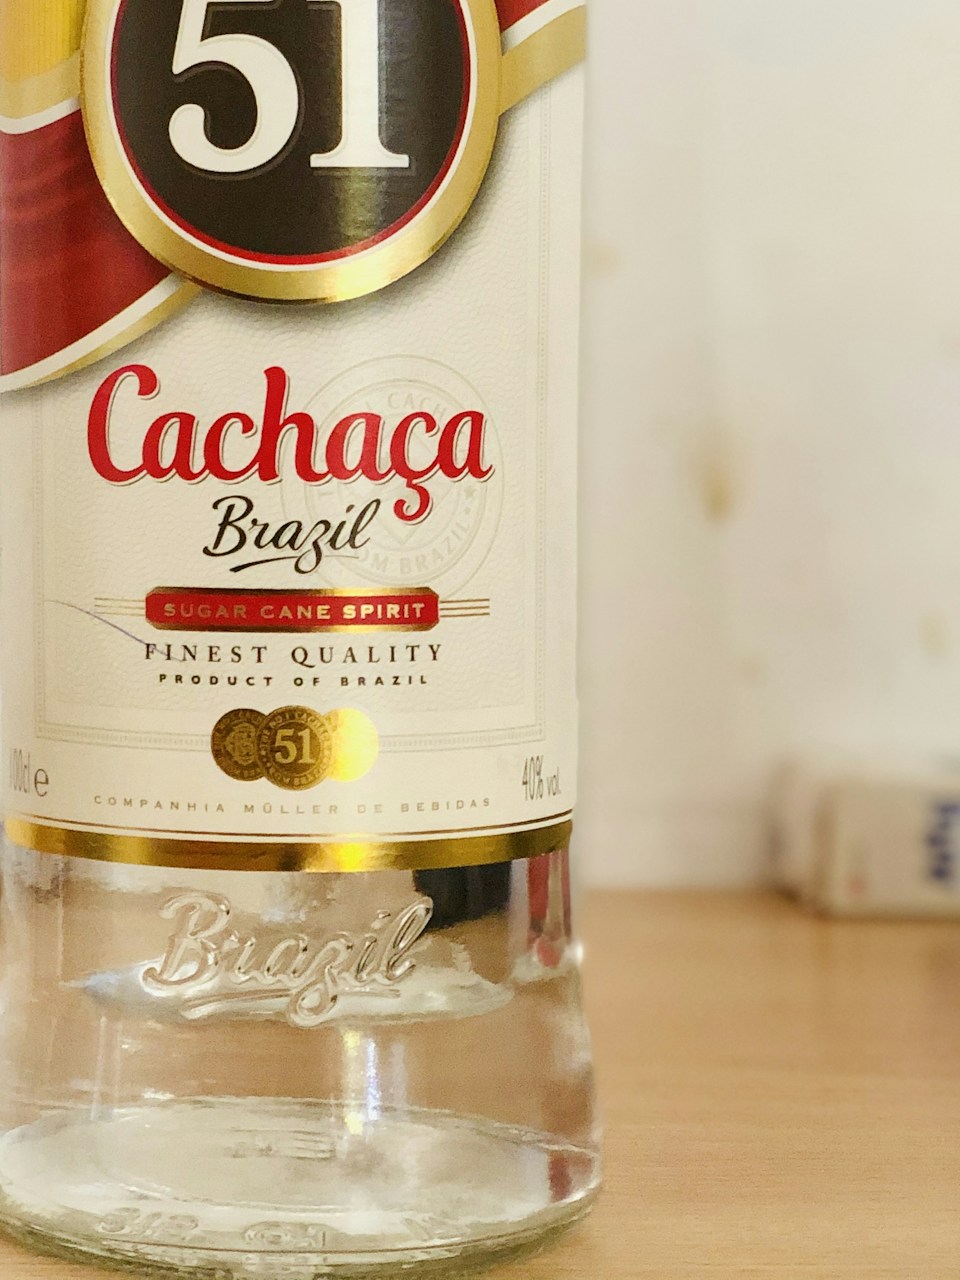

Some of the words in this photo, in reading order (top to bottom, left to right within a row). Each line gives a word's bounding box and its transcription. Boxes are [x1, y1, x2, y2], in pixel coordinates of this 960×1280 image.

[87, 363, 495, 524] Cachaça
[202, 495, 382, 575] Brazil
[163, 603, 247, 619] SUGAR
[260, 604, 332, 620] CANE
[342, 603, 426, 620] SPIRIT
[144, 642, 268, 664] FINEST
[290, 643, 442, 669] QUALITY
[159, 673, 273, 687] PRODUCT
[293, 676, 321, 687] OF
[340, 674, 428, 687] BRAZIL
[274, 728, 315, 764] 51
[522, 755, 544, 801] 40%
[93, 795, 225, 813] COMPANHIA
[356, 804, 384, 814] DE
[400, 797, 491, 813] BEBIDAS
[142, 892, 434, 1028] Brazil
